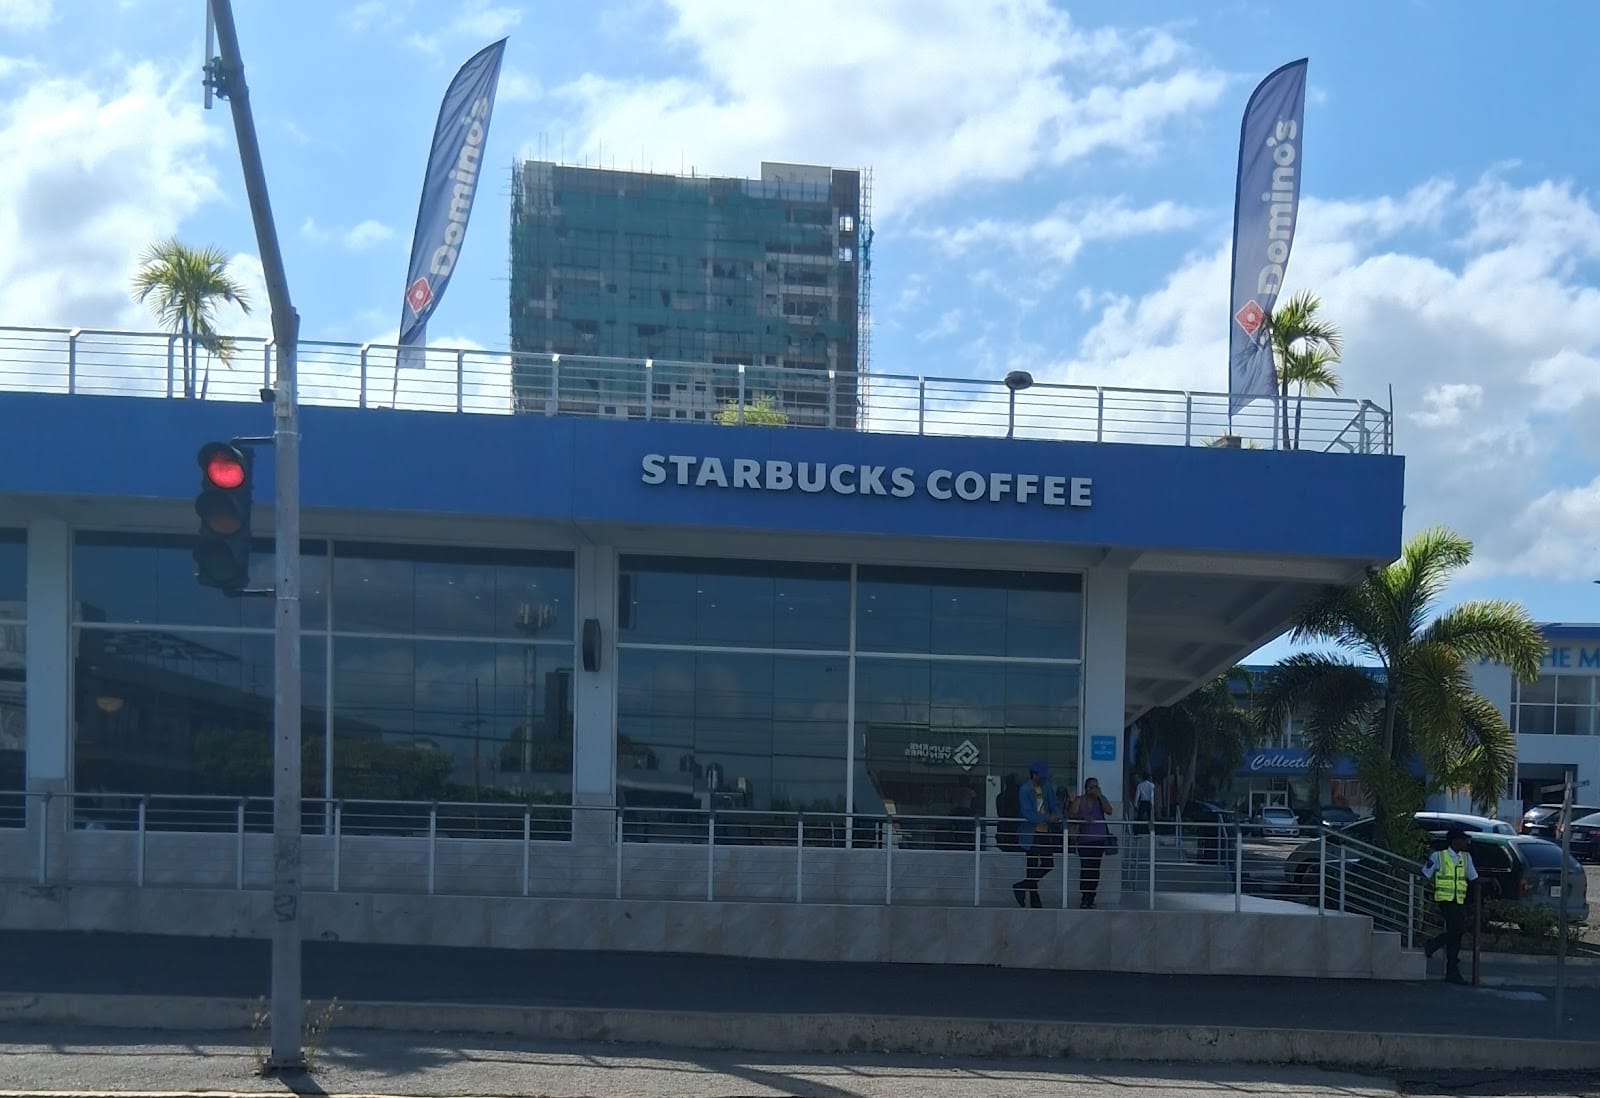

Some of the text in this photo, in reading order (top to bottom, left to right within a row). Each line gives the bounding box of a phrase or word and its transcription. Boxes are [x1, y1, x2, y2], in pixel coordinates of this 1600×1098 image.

[430, 96, 490, 277] Domino's
[1257, 118, 1297, 296] Domino's
[640, 454, 1093, 506] STARBUCKS COFFEE
[1538, 648, 1571, 668] HE
